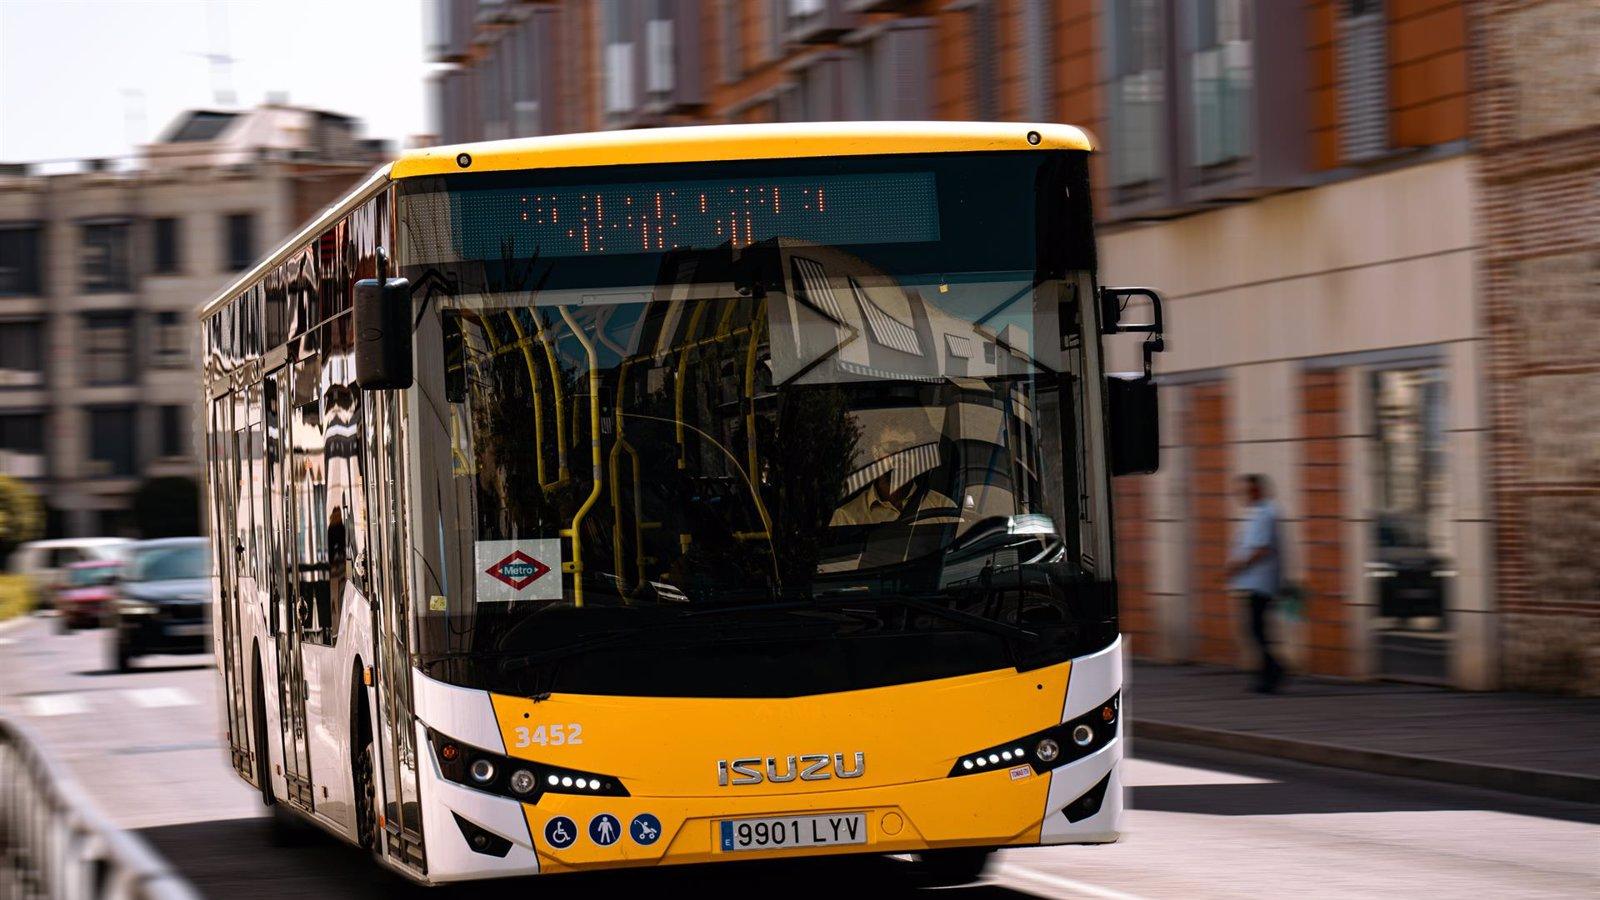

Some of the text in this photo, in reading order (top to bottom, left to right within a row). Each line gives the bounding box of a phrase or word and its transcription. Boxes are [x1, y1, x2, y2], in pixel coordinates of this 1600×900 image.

[504, 566, 533, 575] Metro
[515, 723, 583, 748] 3452
[717, 752, 865, 786] ISUZU
[738, 817, 859, 846] 9901 LYV
